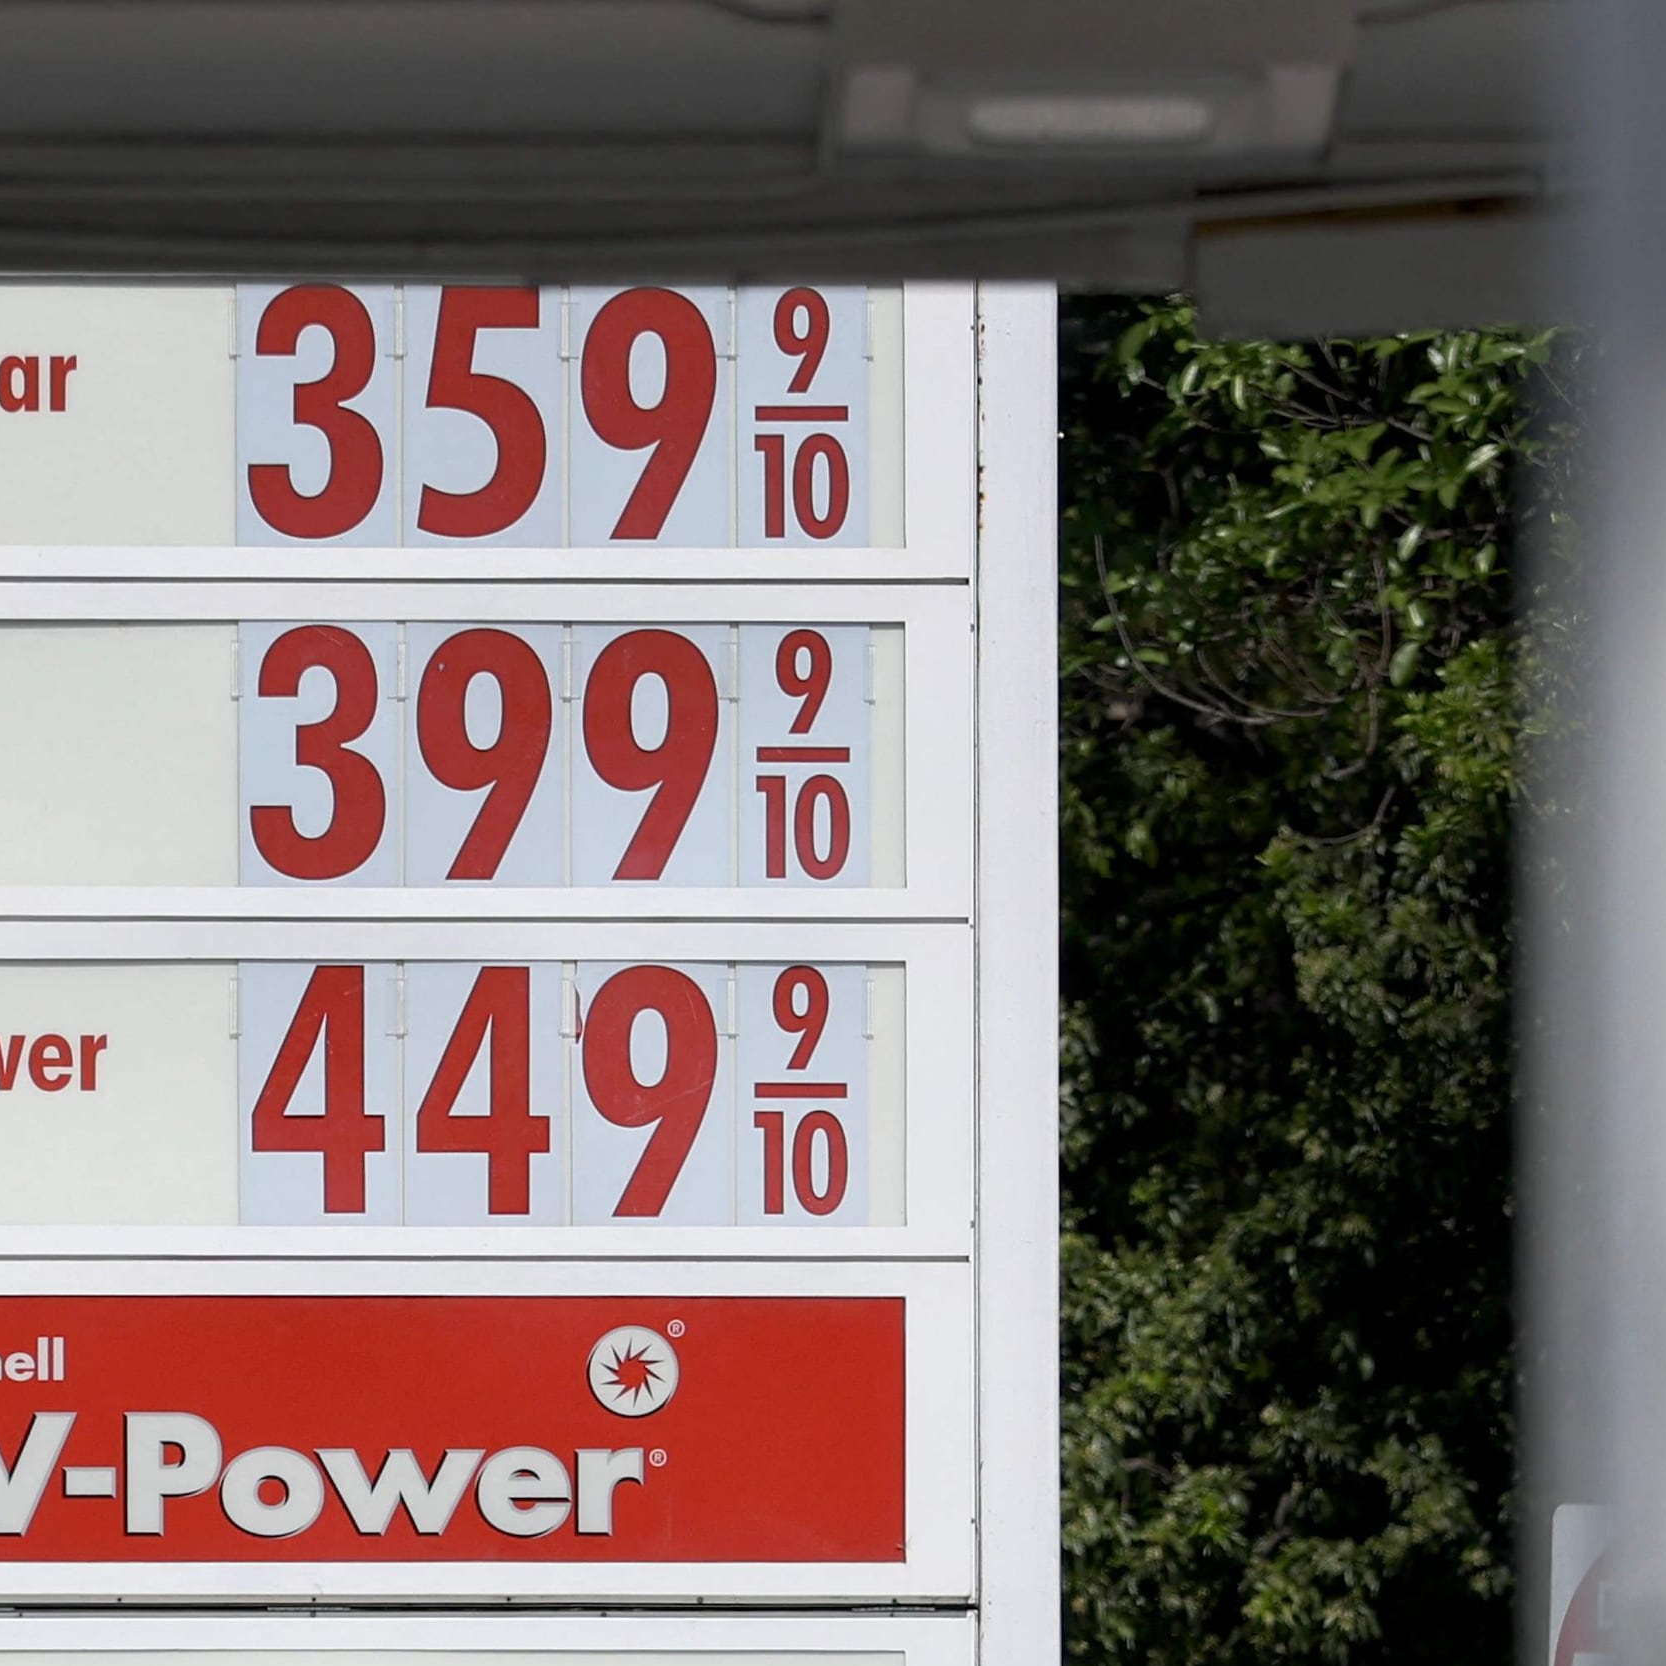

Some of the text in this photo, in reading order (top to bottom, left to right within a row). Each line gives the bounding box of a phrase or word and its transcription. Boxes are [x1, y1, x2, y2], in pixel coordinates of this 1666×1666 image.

[248, 284, 717, 539] 359
[250, 625, 719, 881] 399
[251, 964, 718, 1218] 449
